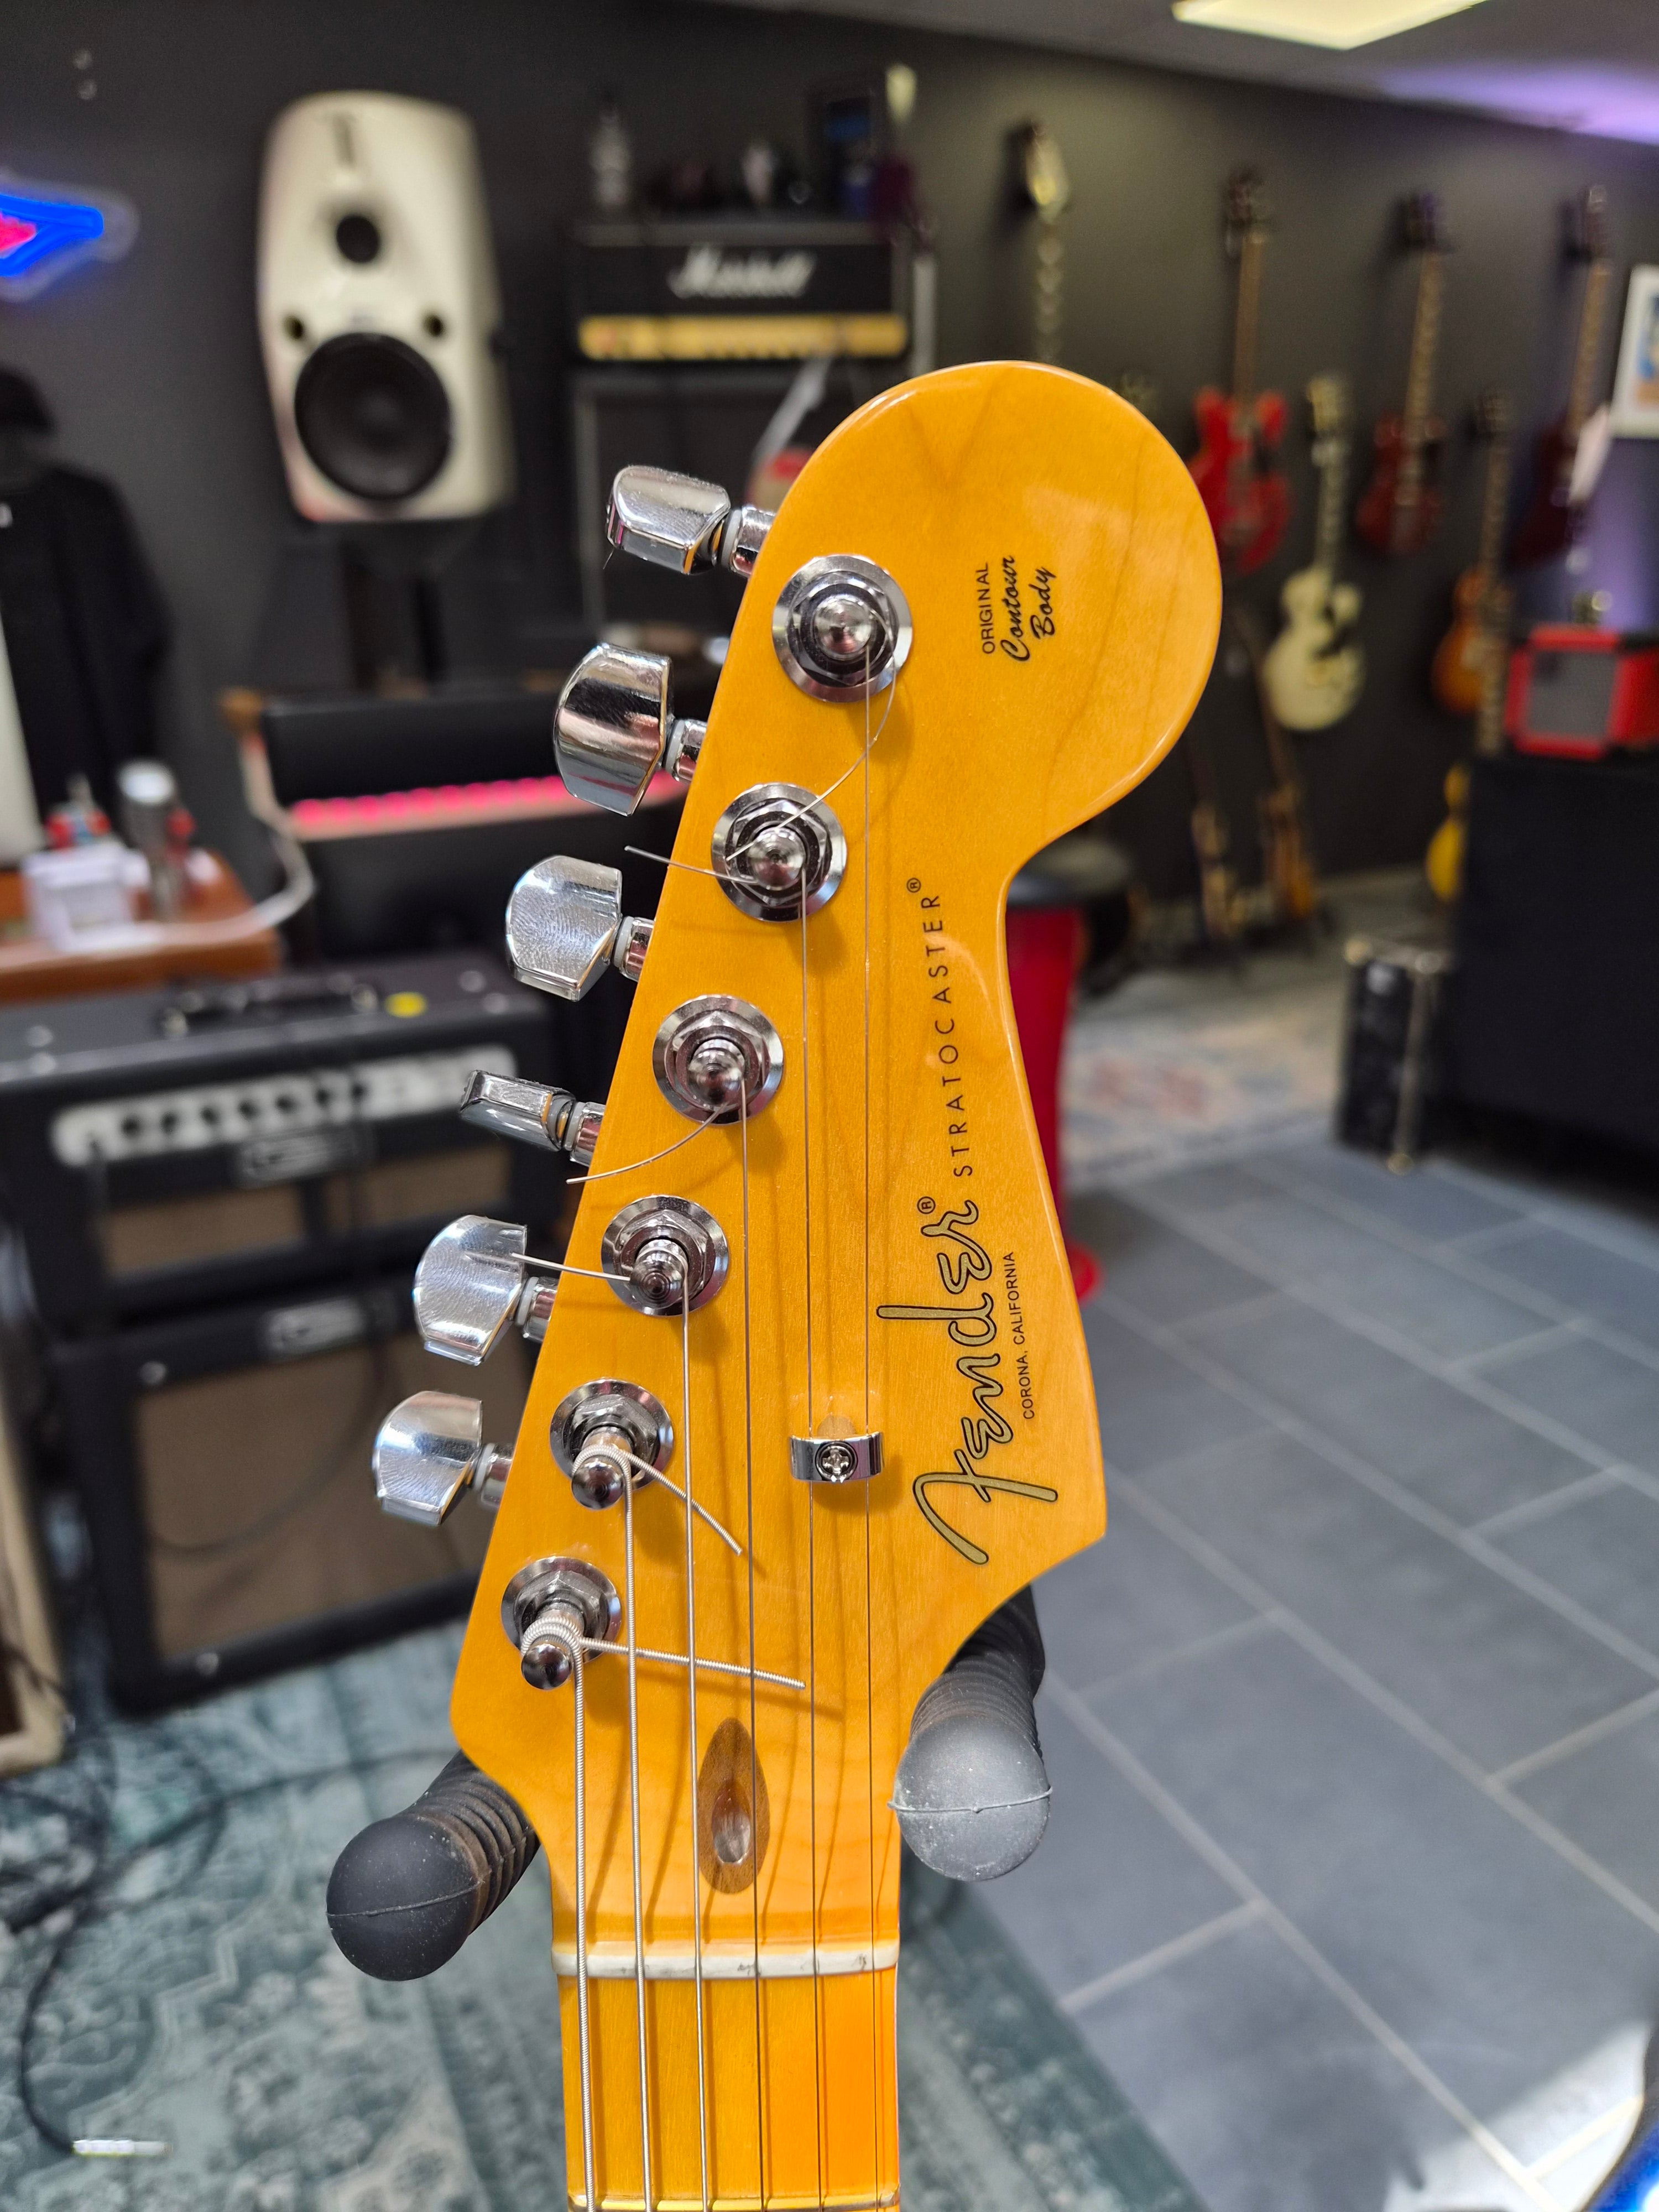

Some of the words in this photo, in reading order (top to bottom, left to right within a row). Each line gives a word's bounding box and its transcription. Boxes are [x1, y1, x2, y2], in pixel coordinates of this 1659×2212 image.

[975, 562, 996, 655] ORIGINAL
[1000, 555, 1031, 662] Contour
[1028, 567, 1057, 640] Body
[1002, 1251, 1026, 1345] CALIFORNIA
